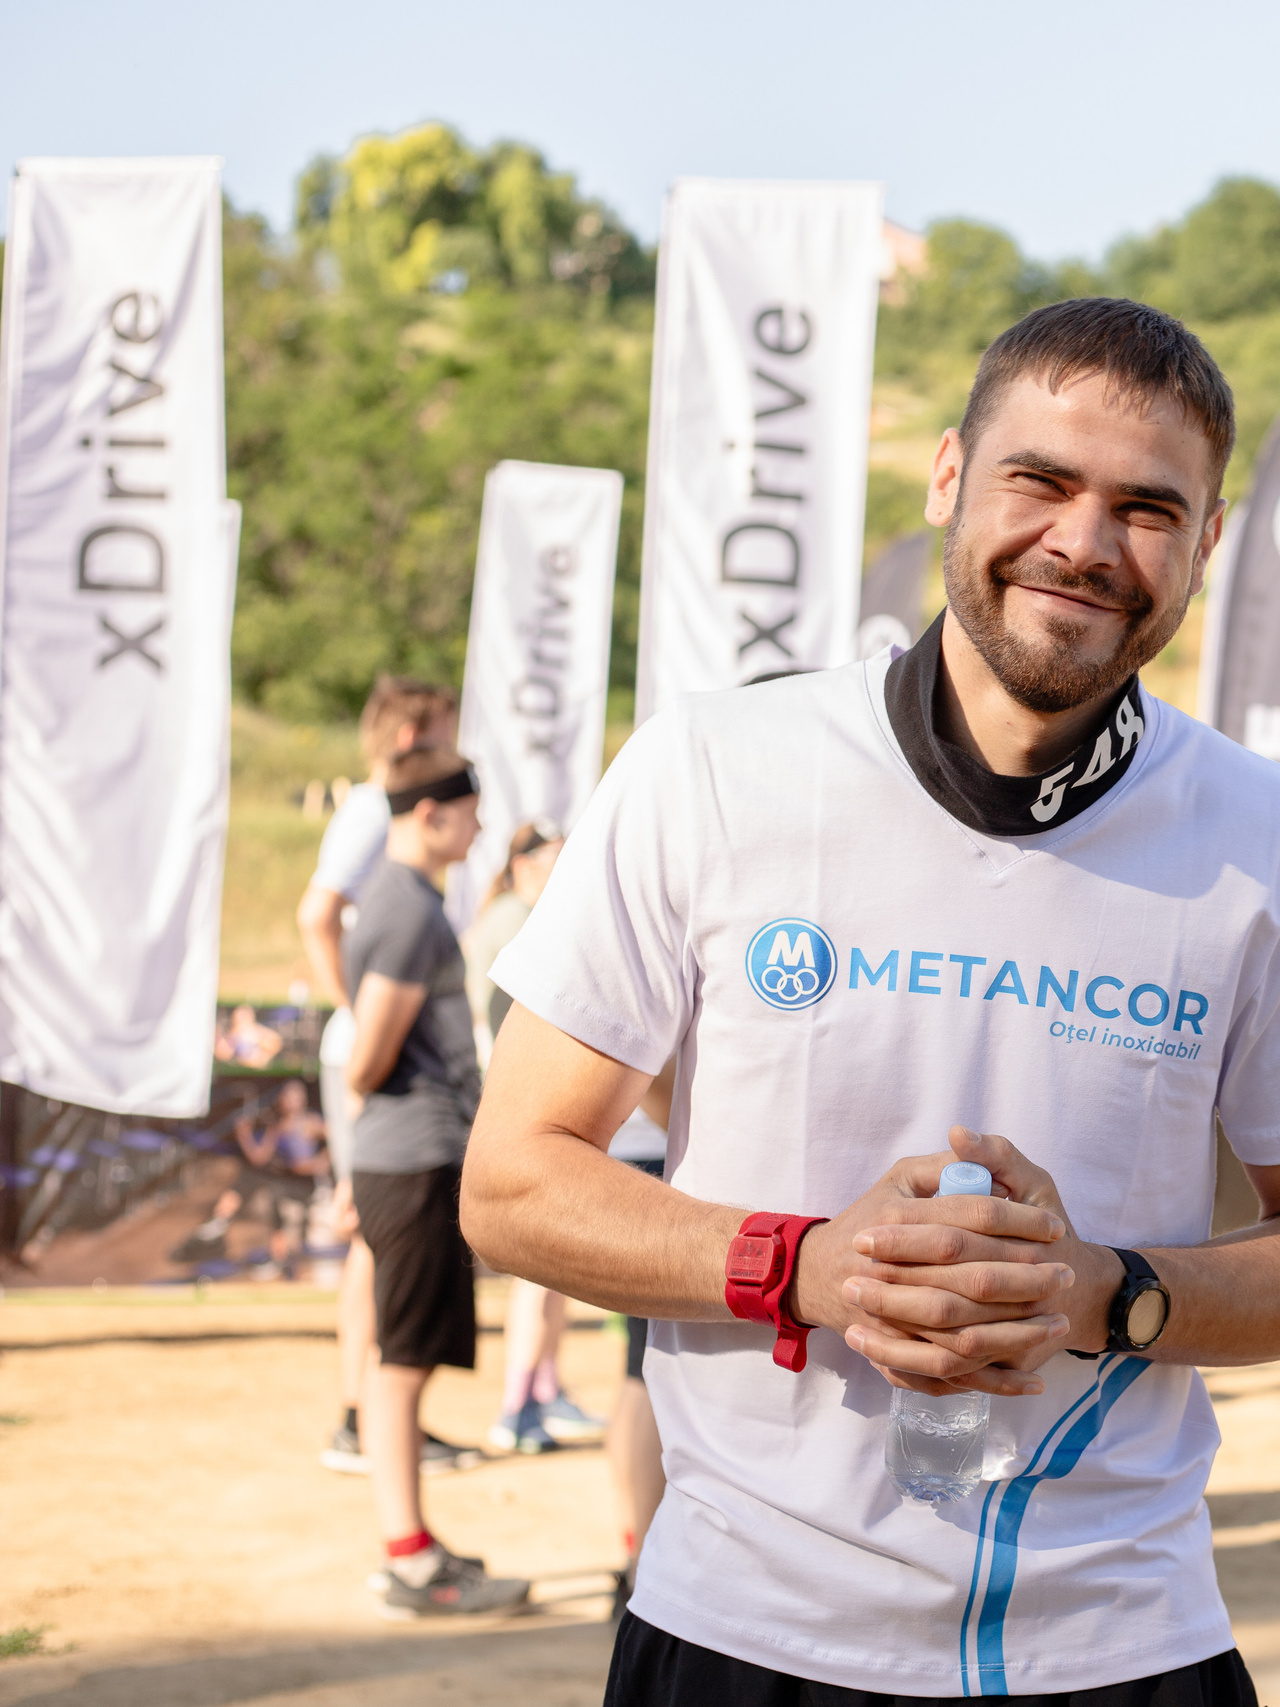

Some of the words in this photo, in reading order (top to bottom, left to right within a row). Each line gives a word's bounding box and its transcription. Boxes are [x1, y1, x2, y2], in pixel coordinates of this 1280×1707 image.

[75, 288, 167, 677] xDrive
[720, 304, 813, 662] xDrive
[509, 541, 580, 762] xDrive
[848, 947, 1210, 1035] METANCOR
[1101, 1028, 1201, 1060] inoxidabil
